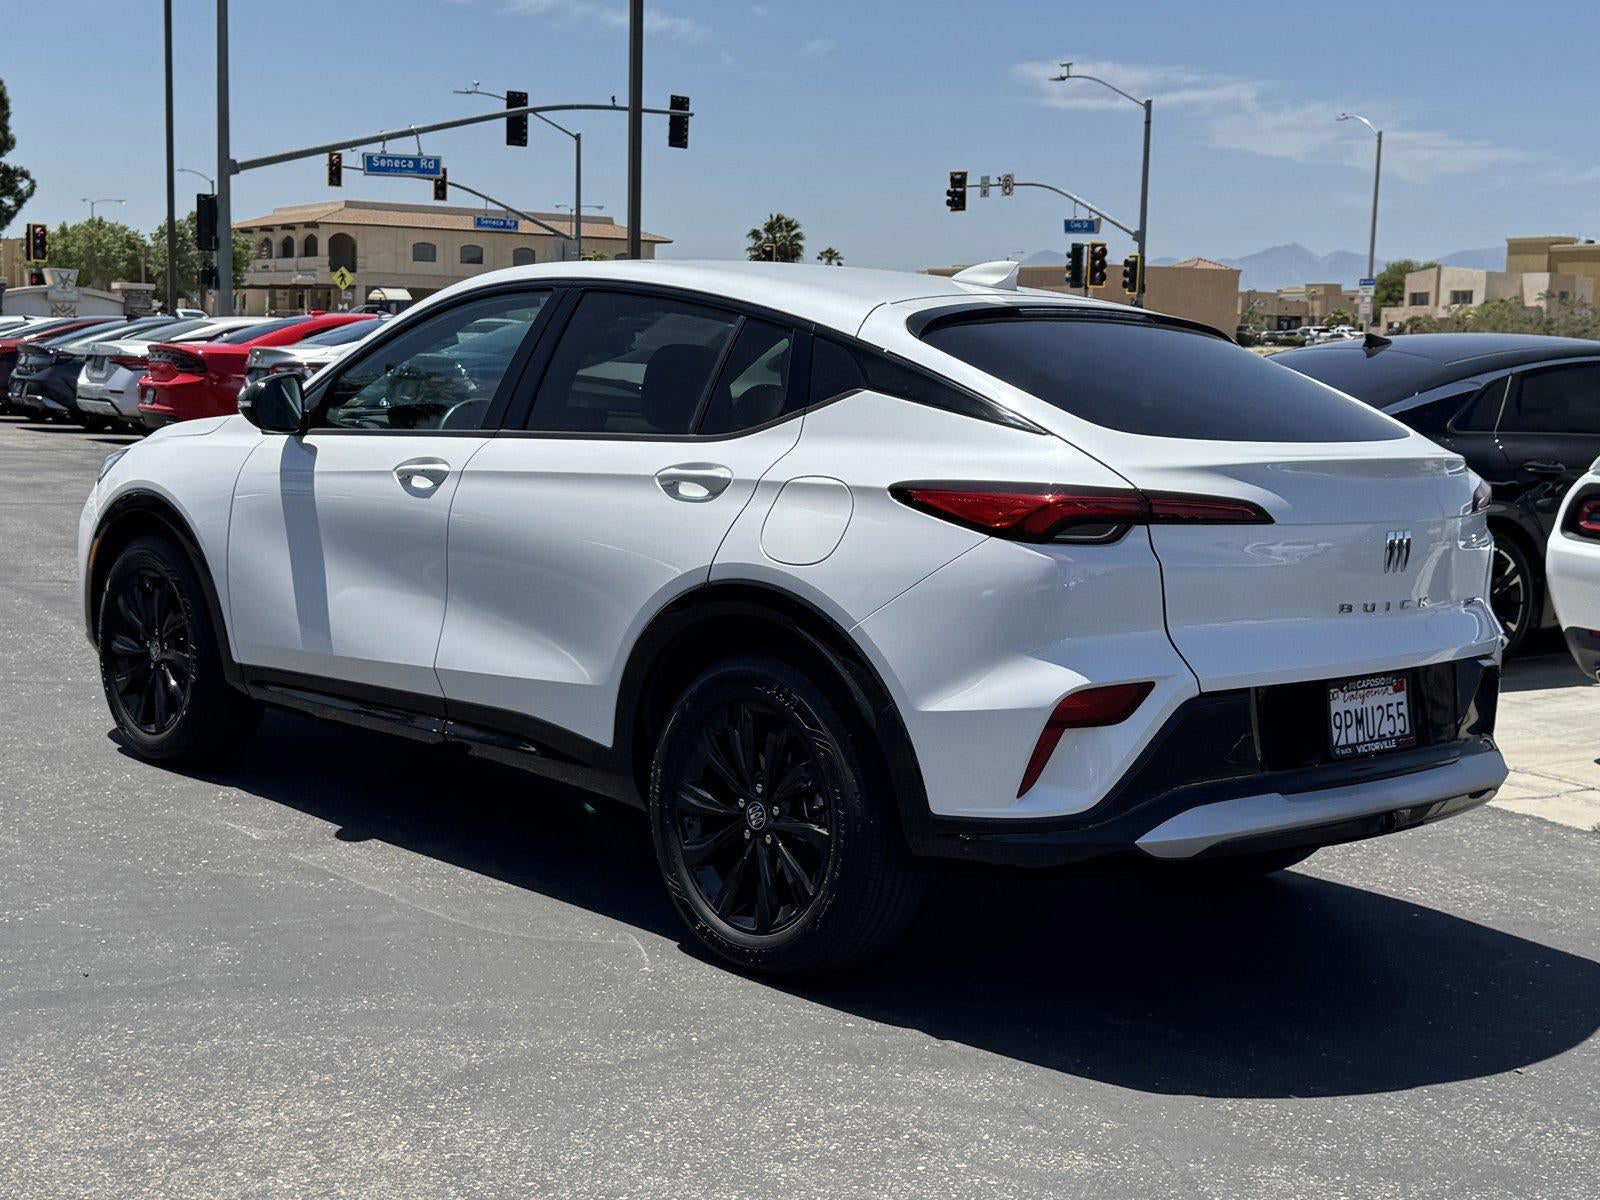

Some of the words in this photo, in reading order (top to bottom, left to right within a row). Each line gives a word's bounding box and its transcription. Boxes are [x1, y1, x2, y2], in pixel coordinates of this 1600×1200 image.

[372, 156, 414, 169] Seneca
[420, 159, 435, 170] Rd
[1342, 684, 1394, 705] California
[1332, 701, 1407, 746] 9PMU255
[1355, 739, 1397, 754] VICTORVILLE
